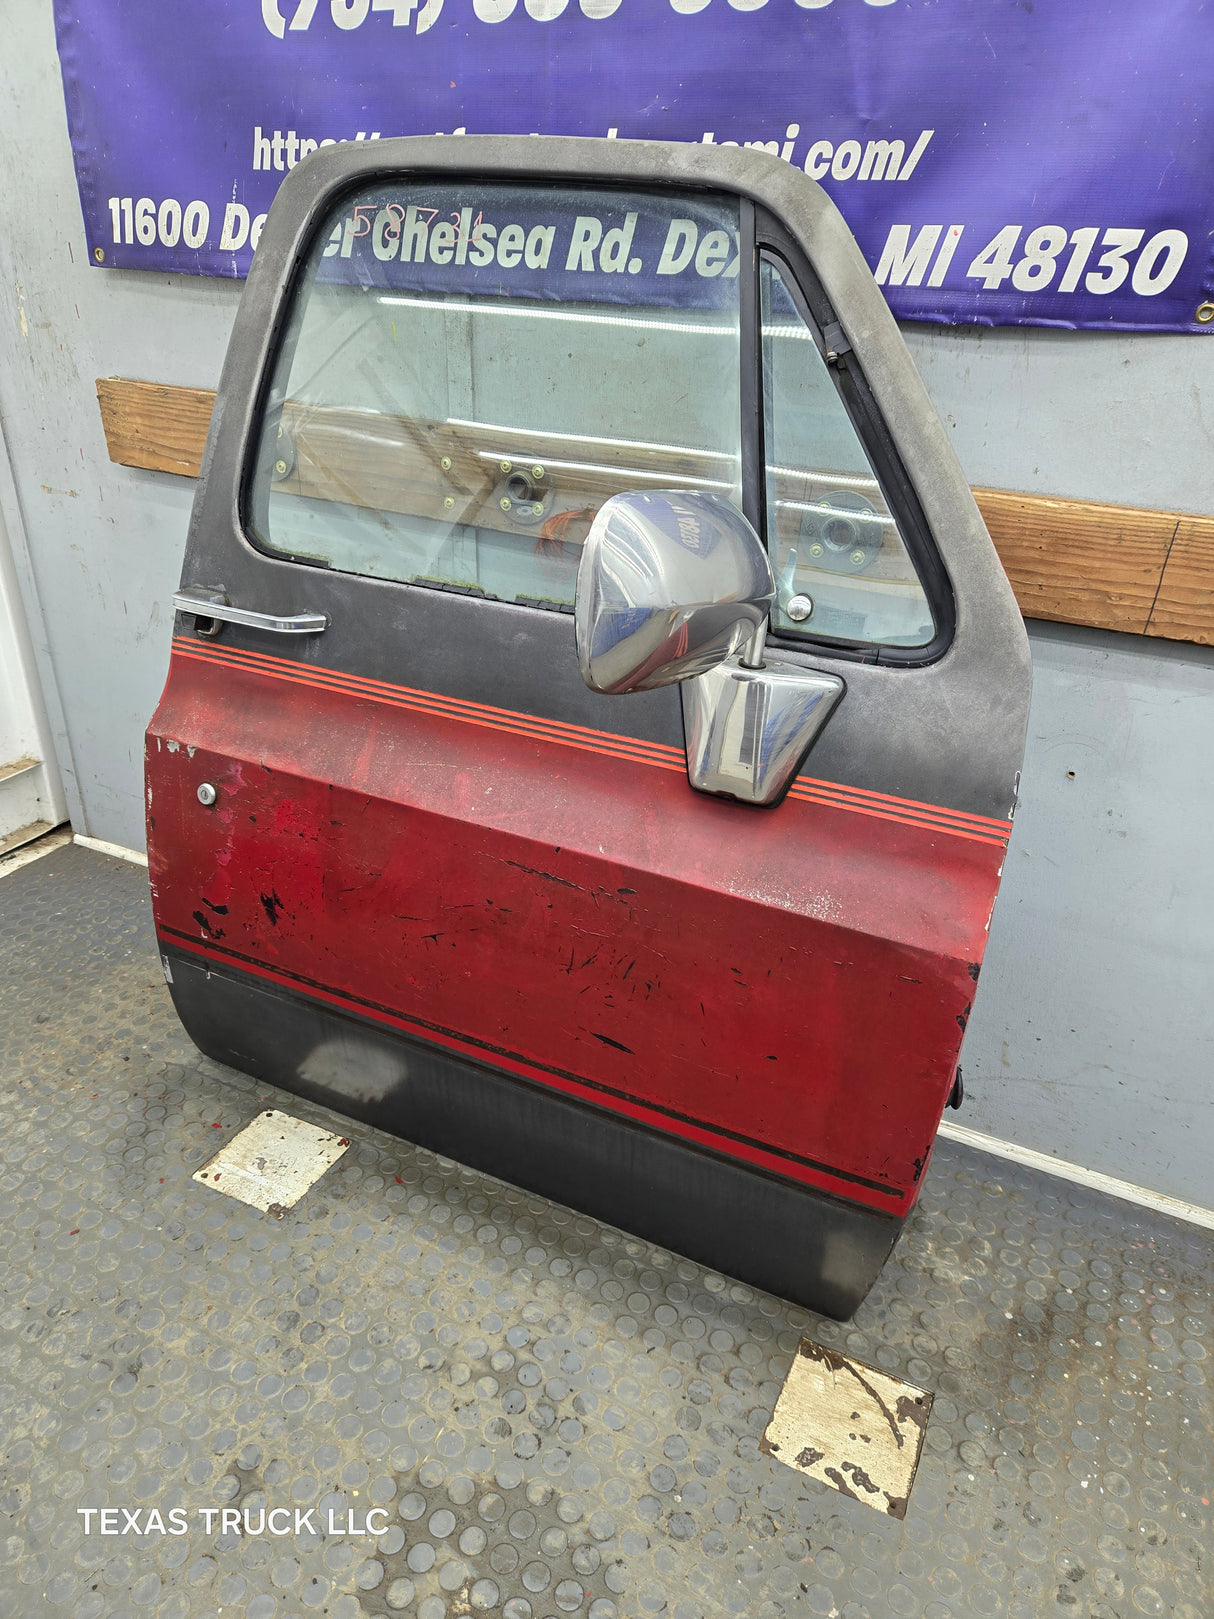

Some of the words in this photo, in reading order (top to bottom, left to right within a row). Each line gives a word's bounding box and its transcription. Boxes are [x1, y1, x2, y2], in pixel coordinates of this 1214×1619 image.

[108, 197, 210, 249] 11600
[372, 206, 557, 270] Chelsea
[565, 212, 643, 274] Rd.
[873, 224, 965, 287] MI
[966, 225, 1189, 297] 48130
